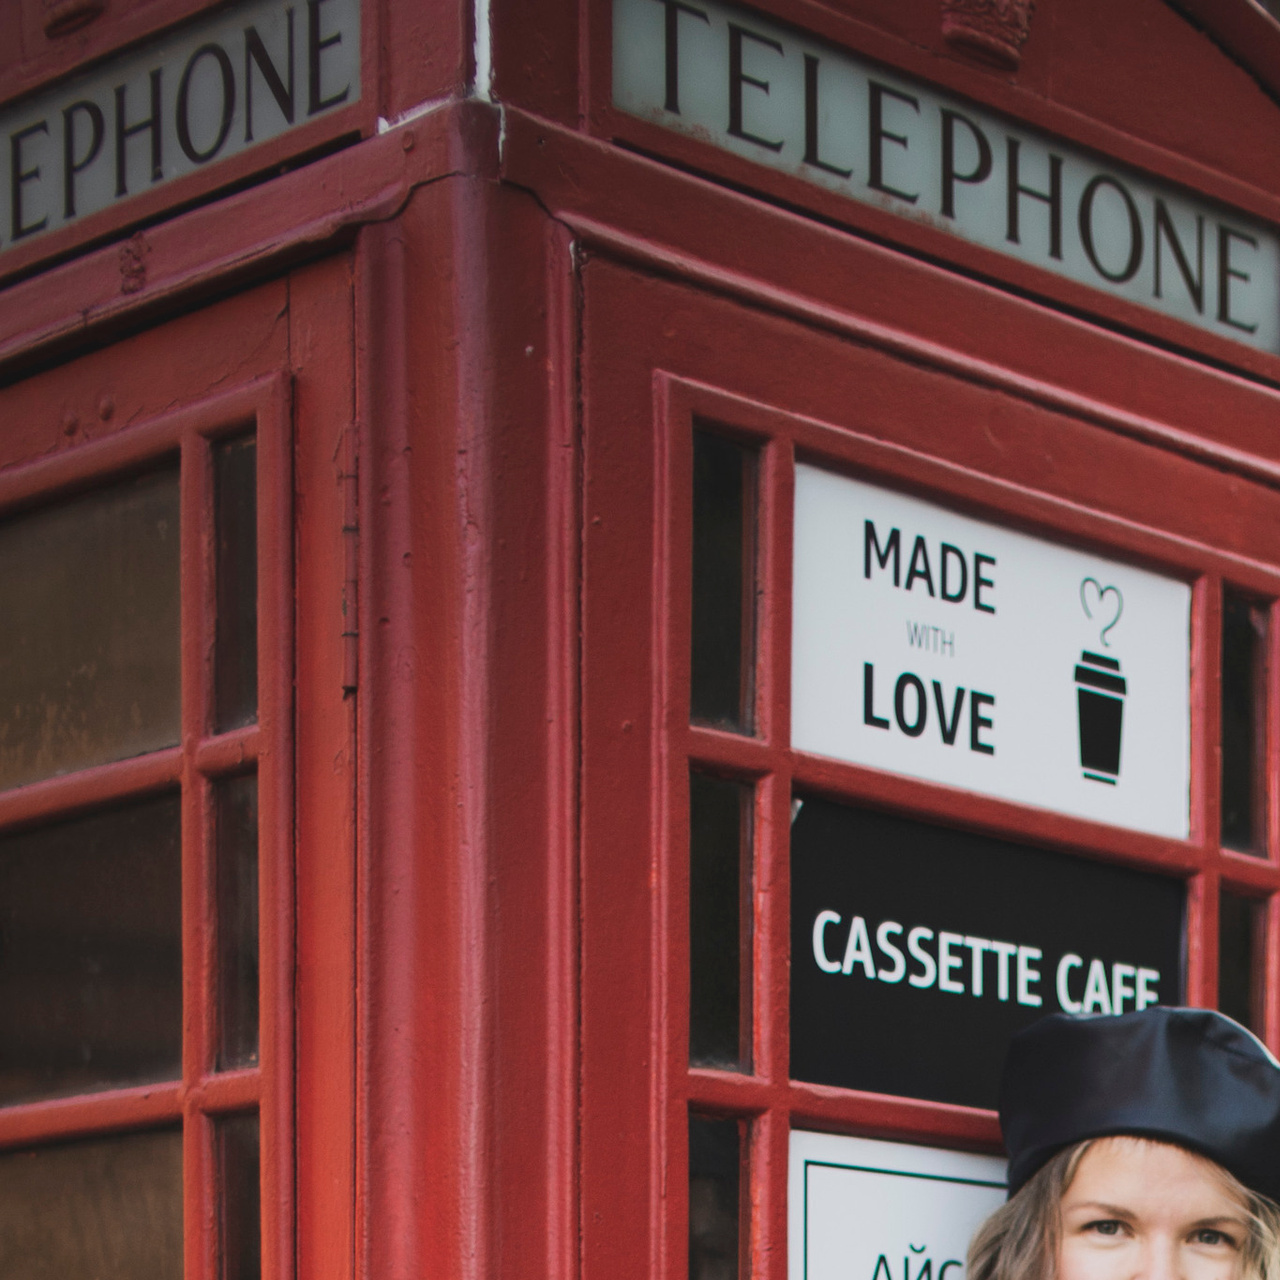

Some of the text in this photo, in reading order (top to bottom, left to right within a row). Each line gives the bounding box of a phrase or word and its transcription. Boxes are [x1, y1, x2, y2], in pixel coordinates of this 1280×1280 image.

[664, 0, 1258, 335] TELEPHONE
[864, 519, 997, 615] MADE
[906, 620, 955, 657] WITH
[863, 662, 995, 756] LOVE
[813, 910, 1042, 1007] CASSETTE
